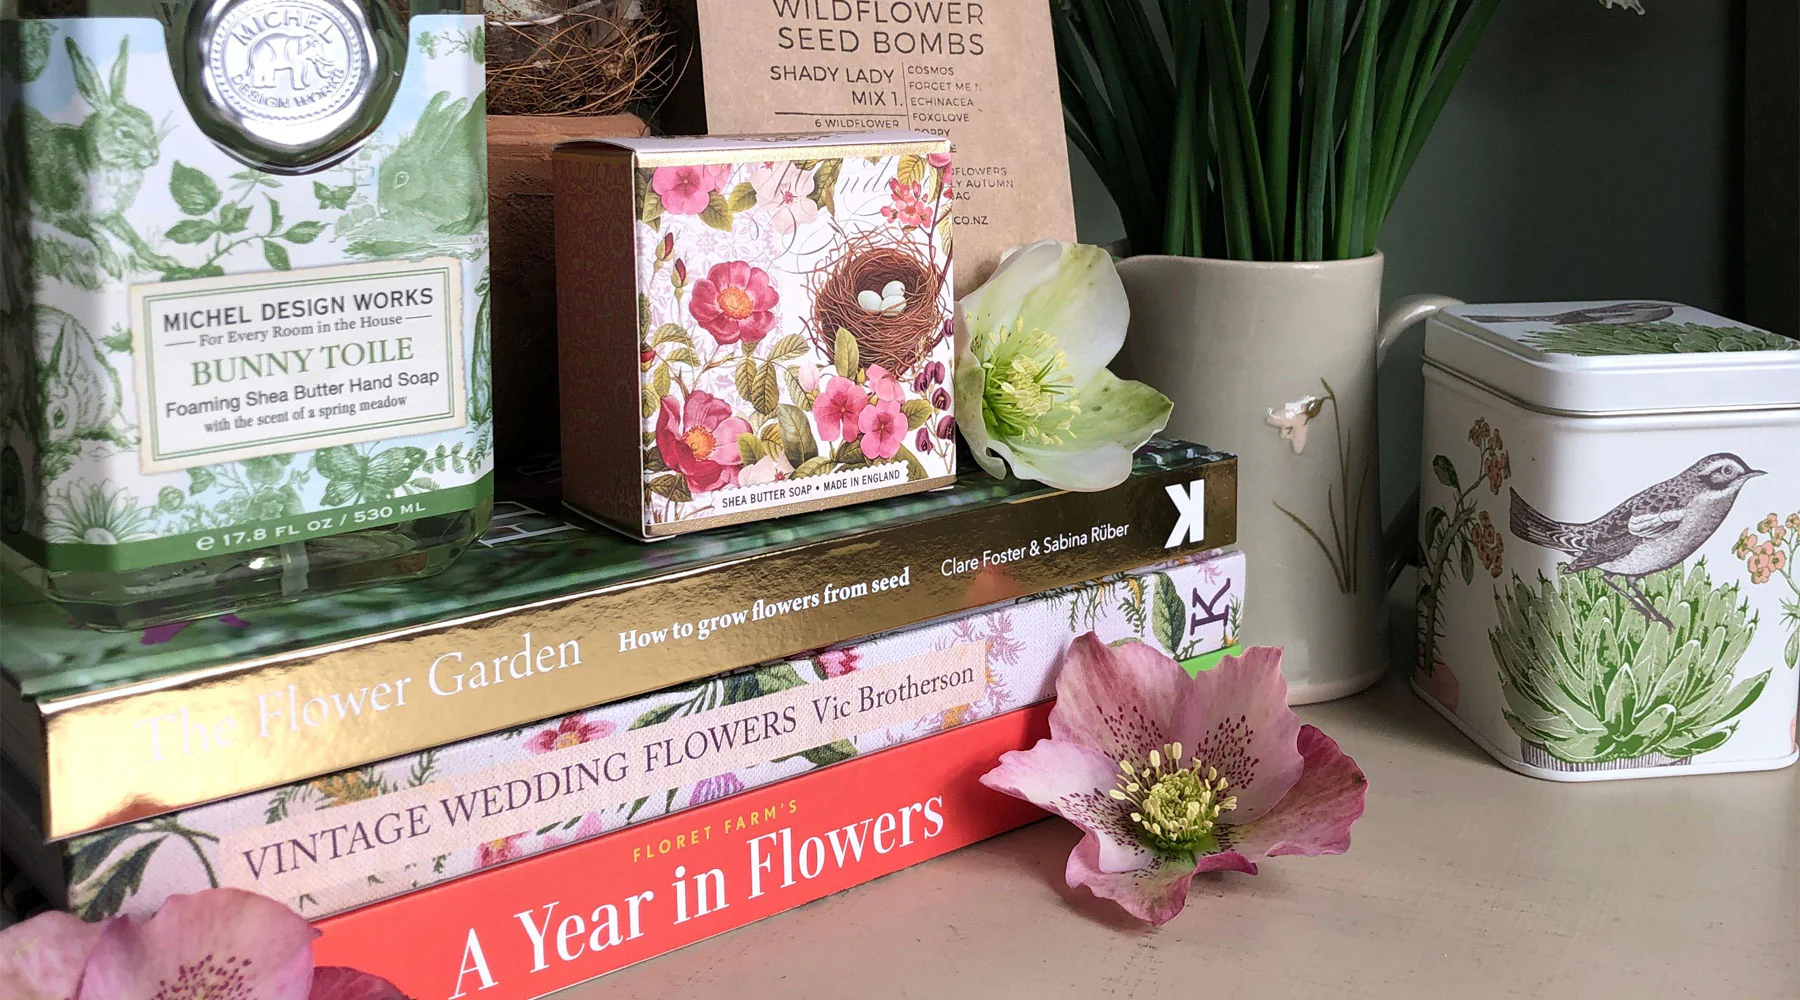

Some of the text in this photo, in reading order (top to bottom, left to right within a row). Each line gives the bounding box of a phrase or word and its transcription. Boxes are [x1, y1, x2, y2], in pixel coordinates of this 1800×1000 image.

[231, 8, 334, 46] MICHEL
[772, 0, 984, 25] WILDFLOWER
[778, 26, 985, 56] SEED BOMBS
[769, 65, 895, 84] SHADY LADY
[907, 65, 955, 76] COSMOS
[909, 81, 952, 91] FORGET
[955, 83, 971, 92] ME
[231, 73, 290, 109] DESIGN
[851, 90, 886, 107] MIX
[910, 96, 975, 107] ECHINACEA
[814, 119, 900, 129] 6 WILDFLOWER
[912, 112, 970, 122] FOXGLOVE
[966, 179, 1014, 188] AUTUMN
[163, 287, 433, 333] MICHEL DESIGN WORKS
[199, 315, 403, 347] For Every Room in the House
[190, 336, 414, 387] BUNNY TOILE
[165, 371, 440, 418] Foaming Shea Butter Hand Soap
[203, 395, 408, 433] with the scent of a spring meadow
[721, 469, 901, 509] SHEA BUTTER SOAP MADE IN ENGLAND
[222, 528, 268, 546] 17.8
[275, 525, 300, 539] FL
[306, 517, 334, 532] OZ
[354, 505, 393, 524] 530
[400, 501, 427, 516] ML
[940, 522, 1130, 577] Clare Foster & Sabina Rüber
[618, 566, 911, 653] How to grow flowers from seed
[134, 631, 582, 764] The Flower Garden
[241, 667, 975, 881] VINTAGE WEDDING FLOWERS Vic Brotherson
[632, 825, 712, 863] FLORET
[447, 795, 946, 1000] A Year in Flowers
